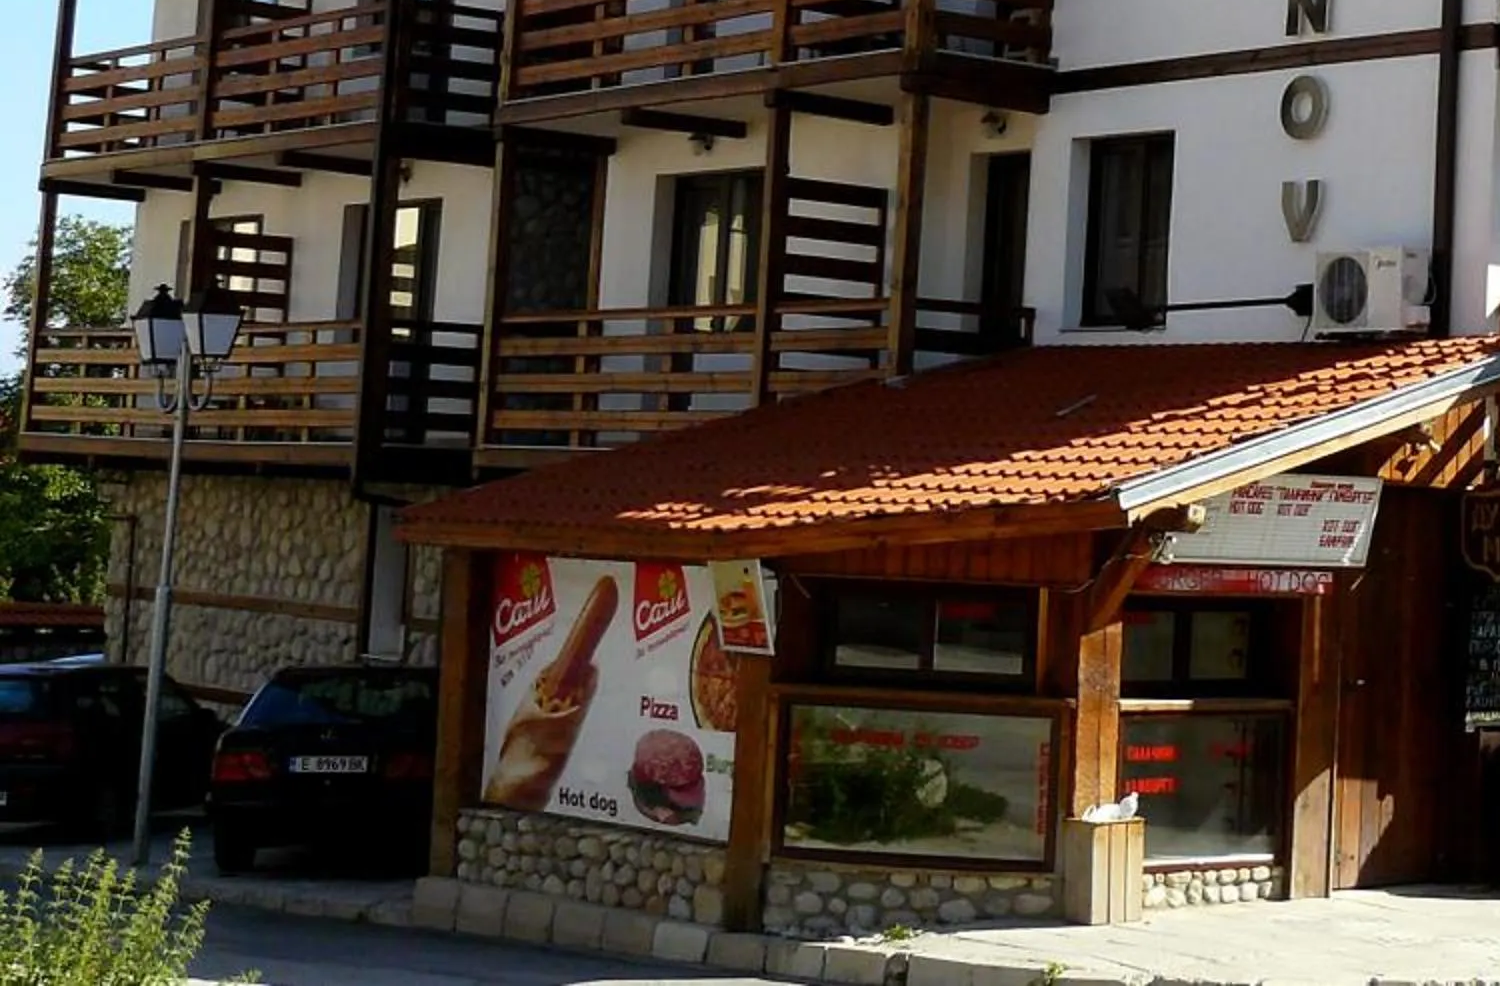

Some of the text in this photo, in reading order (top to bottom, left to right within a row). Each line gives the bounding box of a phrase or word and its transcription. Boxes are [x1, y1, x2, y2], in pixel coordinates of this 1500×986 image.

[640, 695, 679, 721] Pizza
[559, 787, 618, 816] Hot dog
